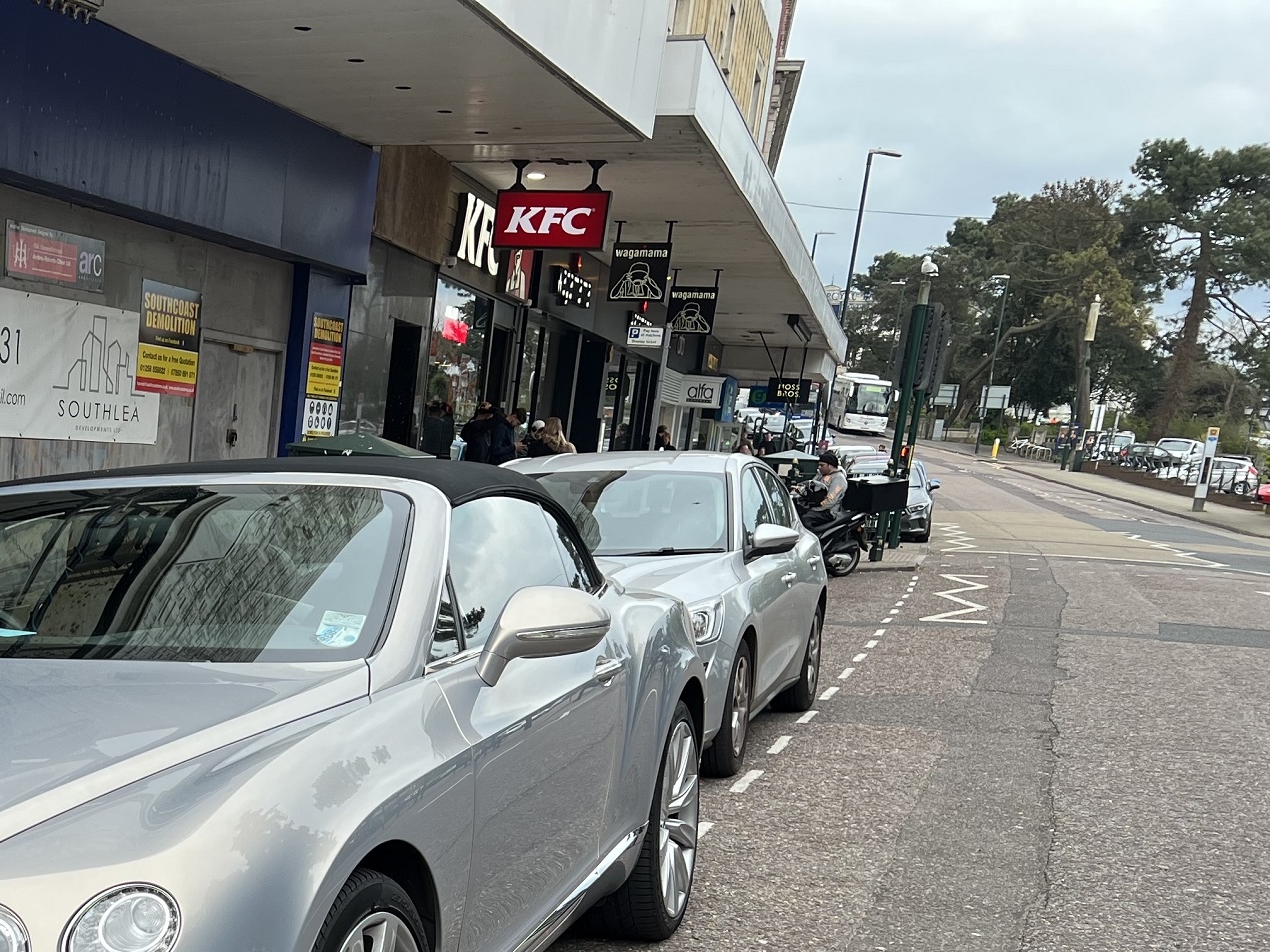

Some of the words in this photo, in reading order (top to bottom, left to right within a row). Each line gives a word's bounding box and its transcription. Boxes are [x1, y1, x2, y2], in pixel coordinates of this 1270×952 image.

[503, 206, 593, 236] KFC
[78, 250, 103, 277] arc
[615, 248, 668, 260] wagamama
[144, 291, 200, 320] SOUTHCOAST
[671, 291, 716, 301] wagamama
[146, 310, 197, 336] DEMOLITION
[687, 383, 714, 399] alfa
[57, 399, 140, 422] SOUTHLEA
